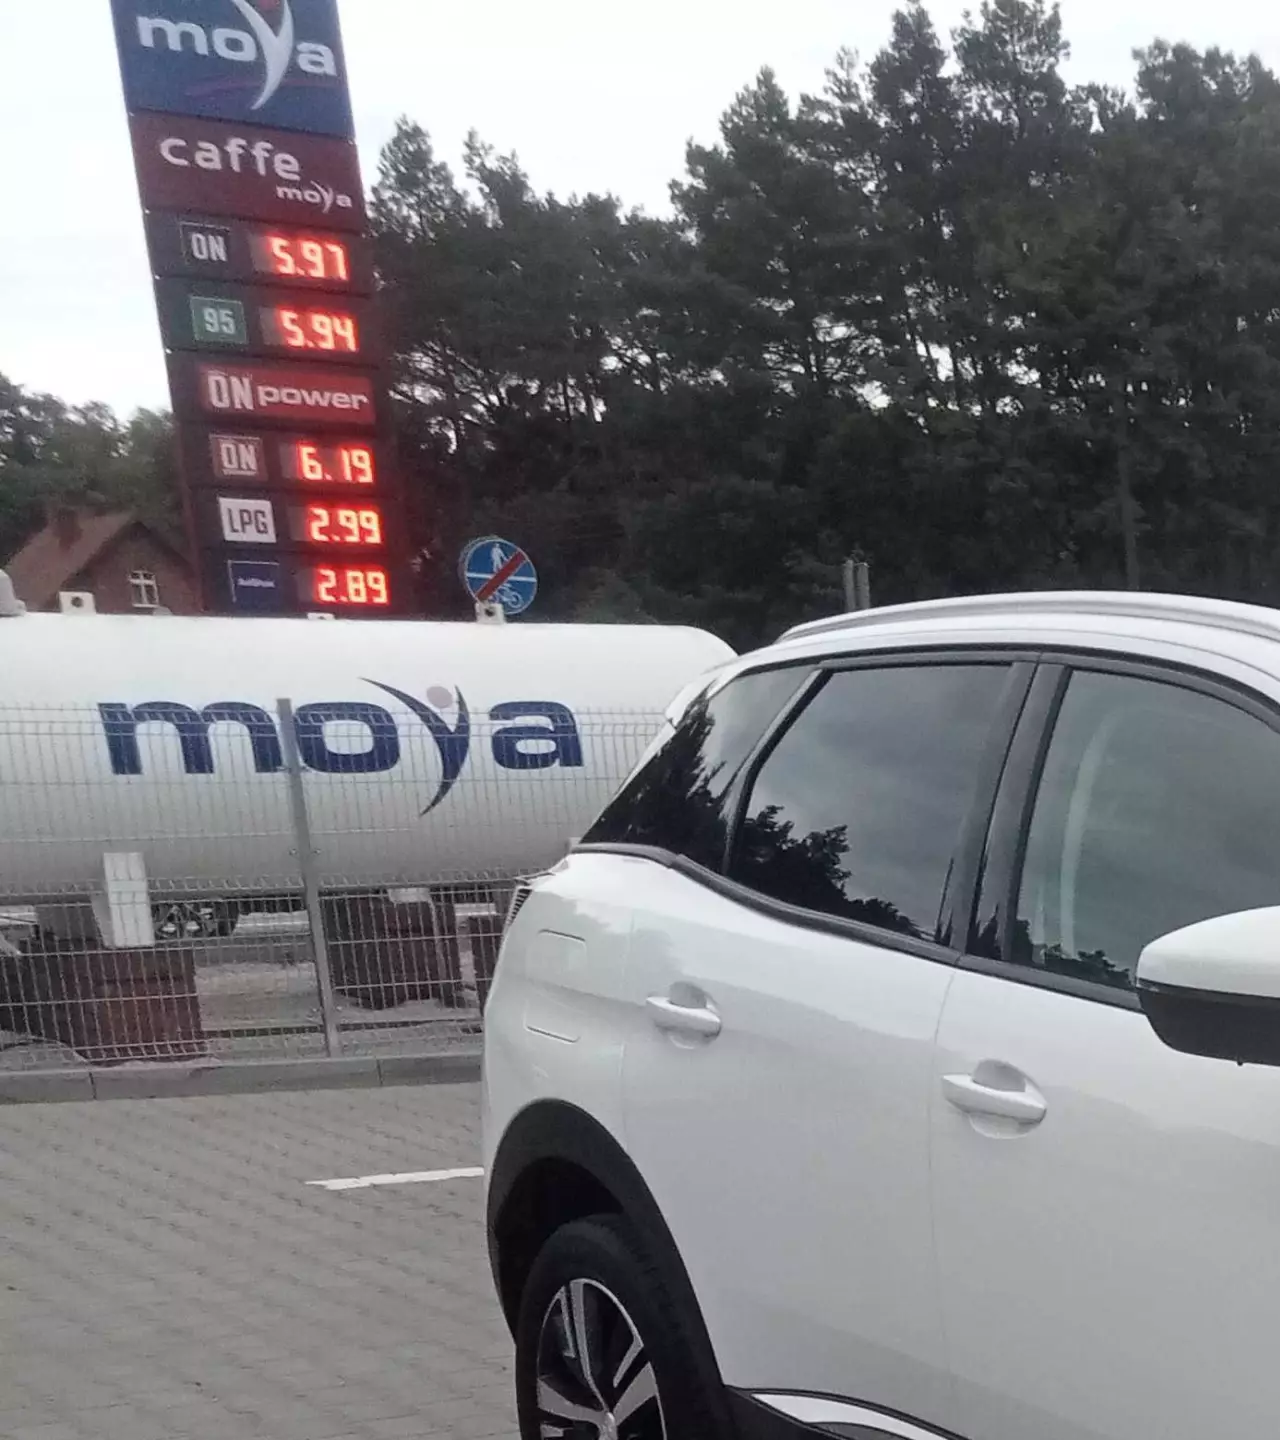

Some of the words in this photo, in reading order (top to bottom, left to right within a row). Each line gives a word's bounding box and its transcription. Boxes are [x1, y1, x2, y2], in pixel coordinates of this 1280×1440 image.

[136, 0, 338, 110] moya
[159, 137, 300, 181] caffe
[276, 180, 352, 213] moya
[190, 232, 227, 262] ON
[269, 237, 348, 280] 5.97
[203, 307, 236, 335] 95
[279, 308, 358, 353] 5.94
[207, 372, 254, 411] ON
[257, 384, 368, 410] power
[221, 443, 257, 473] ON
[299, 444, 374, 484] 6.19
[228, 509, 269, 534] LPG
[310, 508, 381, 545] 2.99
[318, 568, 389, 605] 2.89
[97, 676, 585, 817] moya
